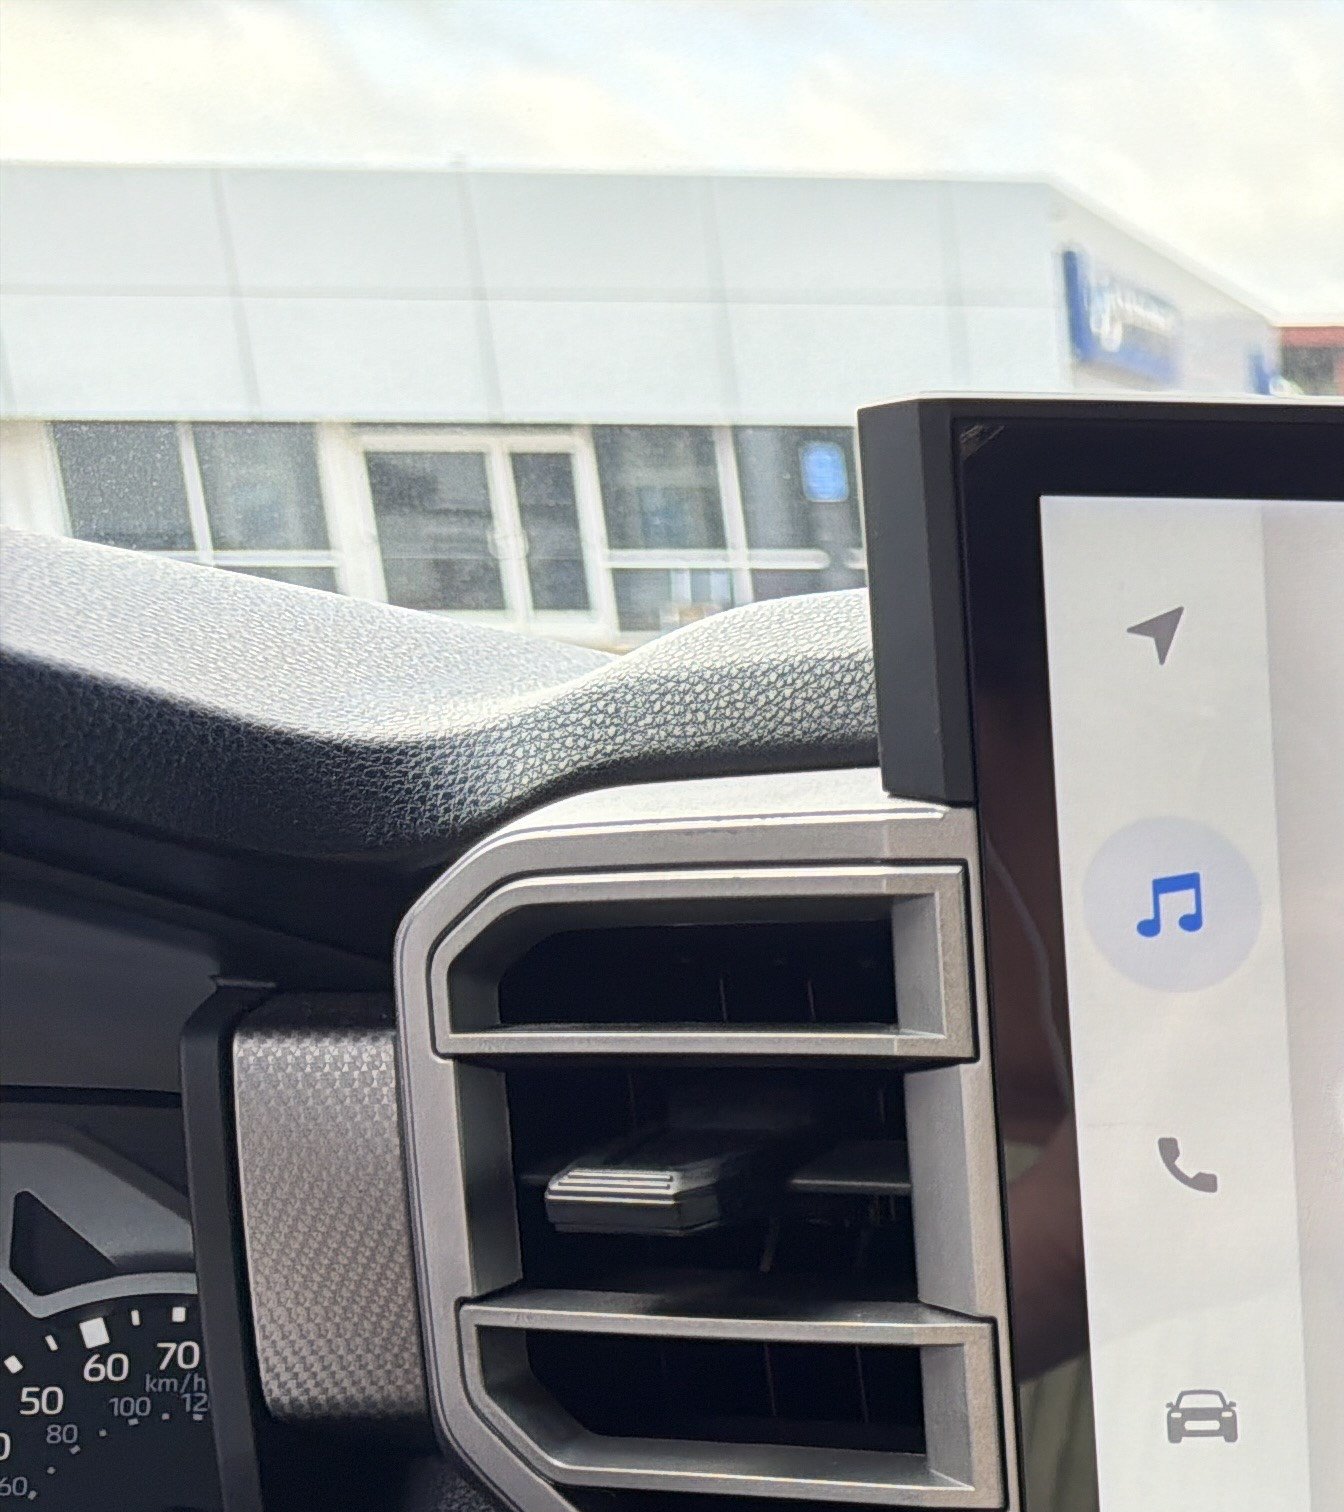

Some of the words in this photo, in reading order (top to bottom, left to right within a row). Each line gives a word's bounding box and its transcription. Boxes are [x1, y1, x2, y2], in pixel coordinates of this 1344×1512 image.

[156, 1340, 201, 1371] 70
[83, 1353, 130, 1383] 60
[145, 1373, 207, 1394] km/h
[19, 1386, 65, 1416] 50
[108, 1396, 152, 1418] 100
[180, 1392, 209, 1413] 12
[45, 1424, 79, 1445] 80
